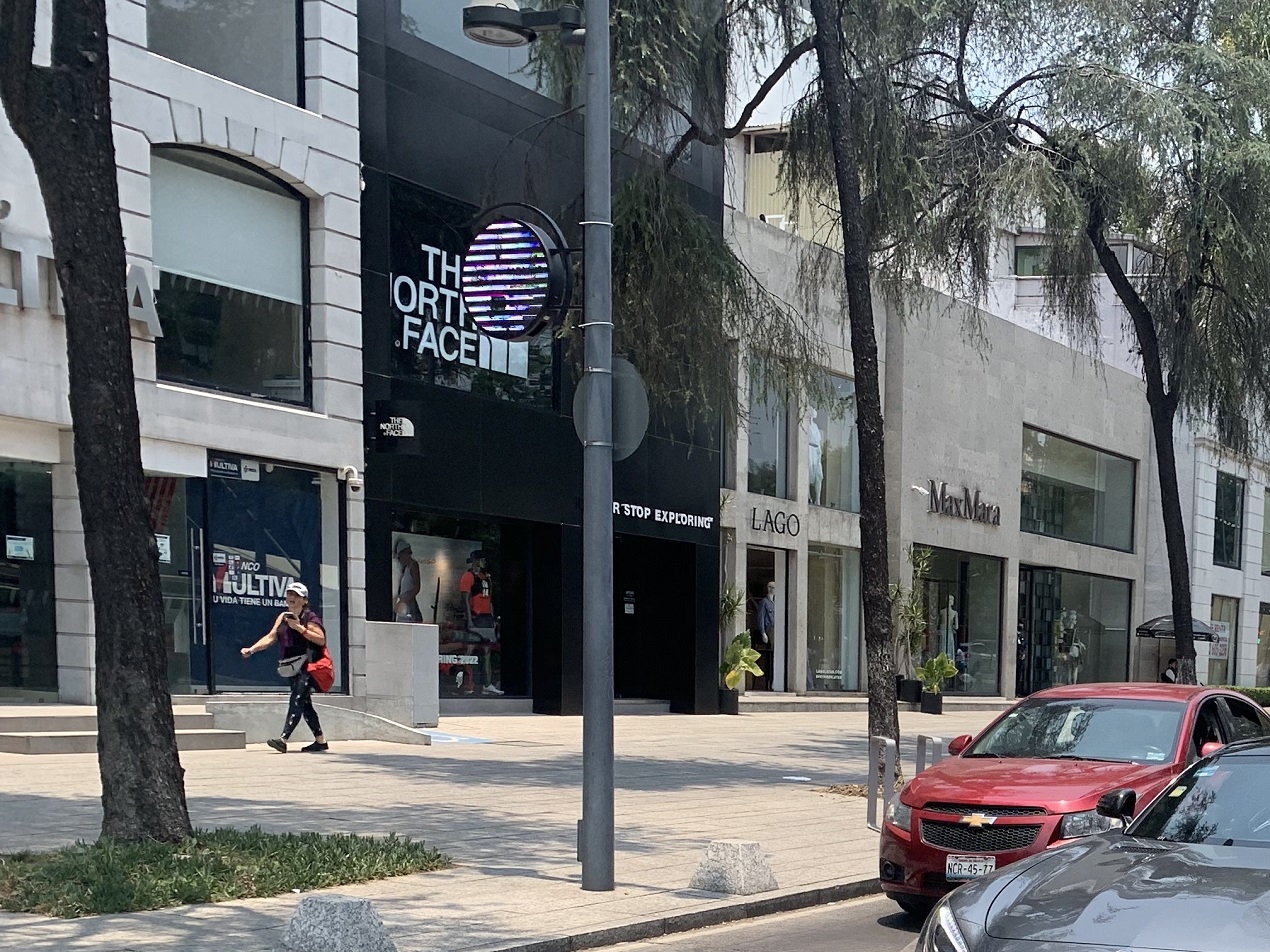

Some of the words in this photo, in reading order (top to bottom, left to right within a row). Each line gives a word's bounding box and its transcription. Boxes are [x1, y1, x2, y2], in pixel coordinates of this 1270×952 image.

[421, 243, 461, 289] TH
[402, 315, 477, 367] FACE
[623, 503, 651, 519] STOP
[927, 480, 1000, 526] MaxMara
[752, 507, 800, 536] LAGO
[241, 561, 260, 571] NCO
[219, 596, 238, 604] VIDA
[239, 597, 261, 606] TIENE
[439, 655, 458, 664] RING
[948, 863, 993, 875] NCR-45-77
